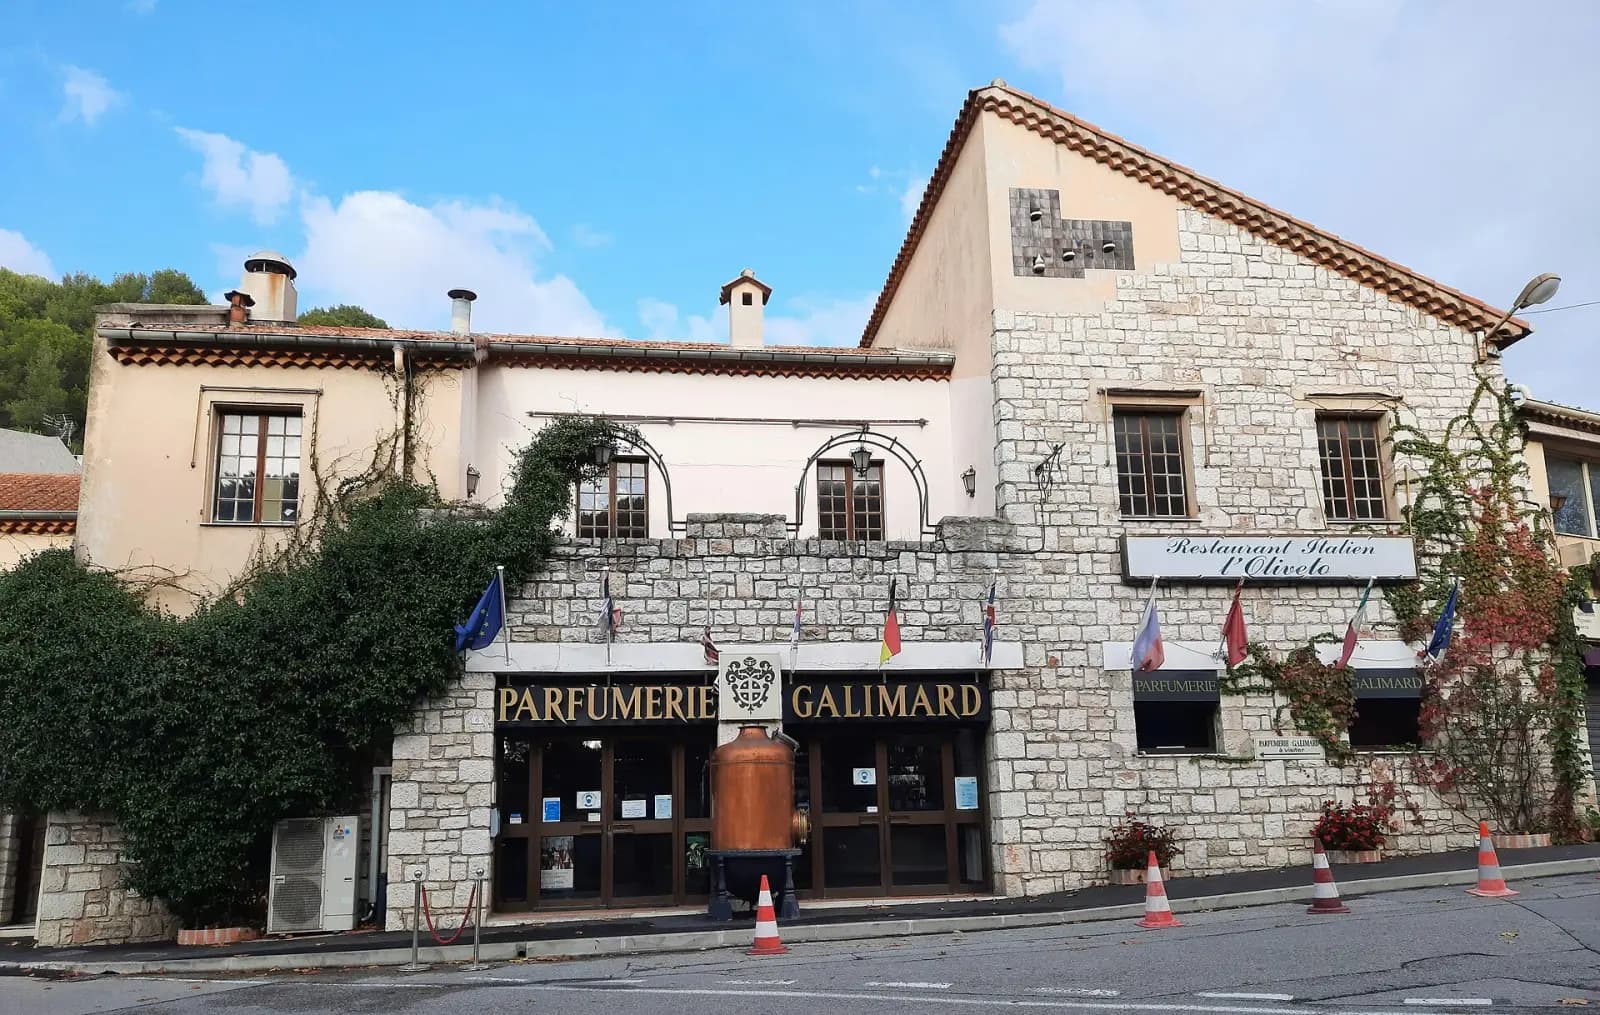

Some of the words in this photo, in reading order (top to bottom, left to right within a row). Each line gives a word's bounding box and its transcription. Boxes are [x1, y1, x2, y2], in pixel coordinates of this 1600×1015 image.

[1166, 537, 1292, 555] Restaurant
[1301, 538, 1376, 555] Italien
[1219, 555, 1331, 576] l'Oliveto
[1135, 679, 1217, 692] PARFUMERIE
[497, 685, 717, 725] PARFUMERIE
[792, 684, 982, 720] GALIMARD
[1258, 739, 1289, 747] PARFUMERIE
